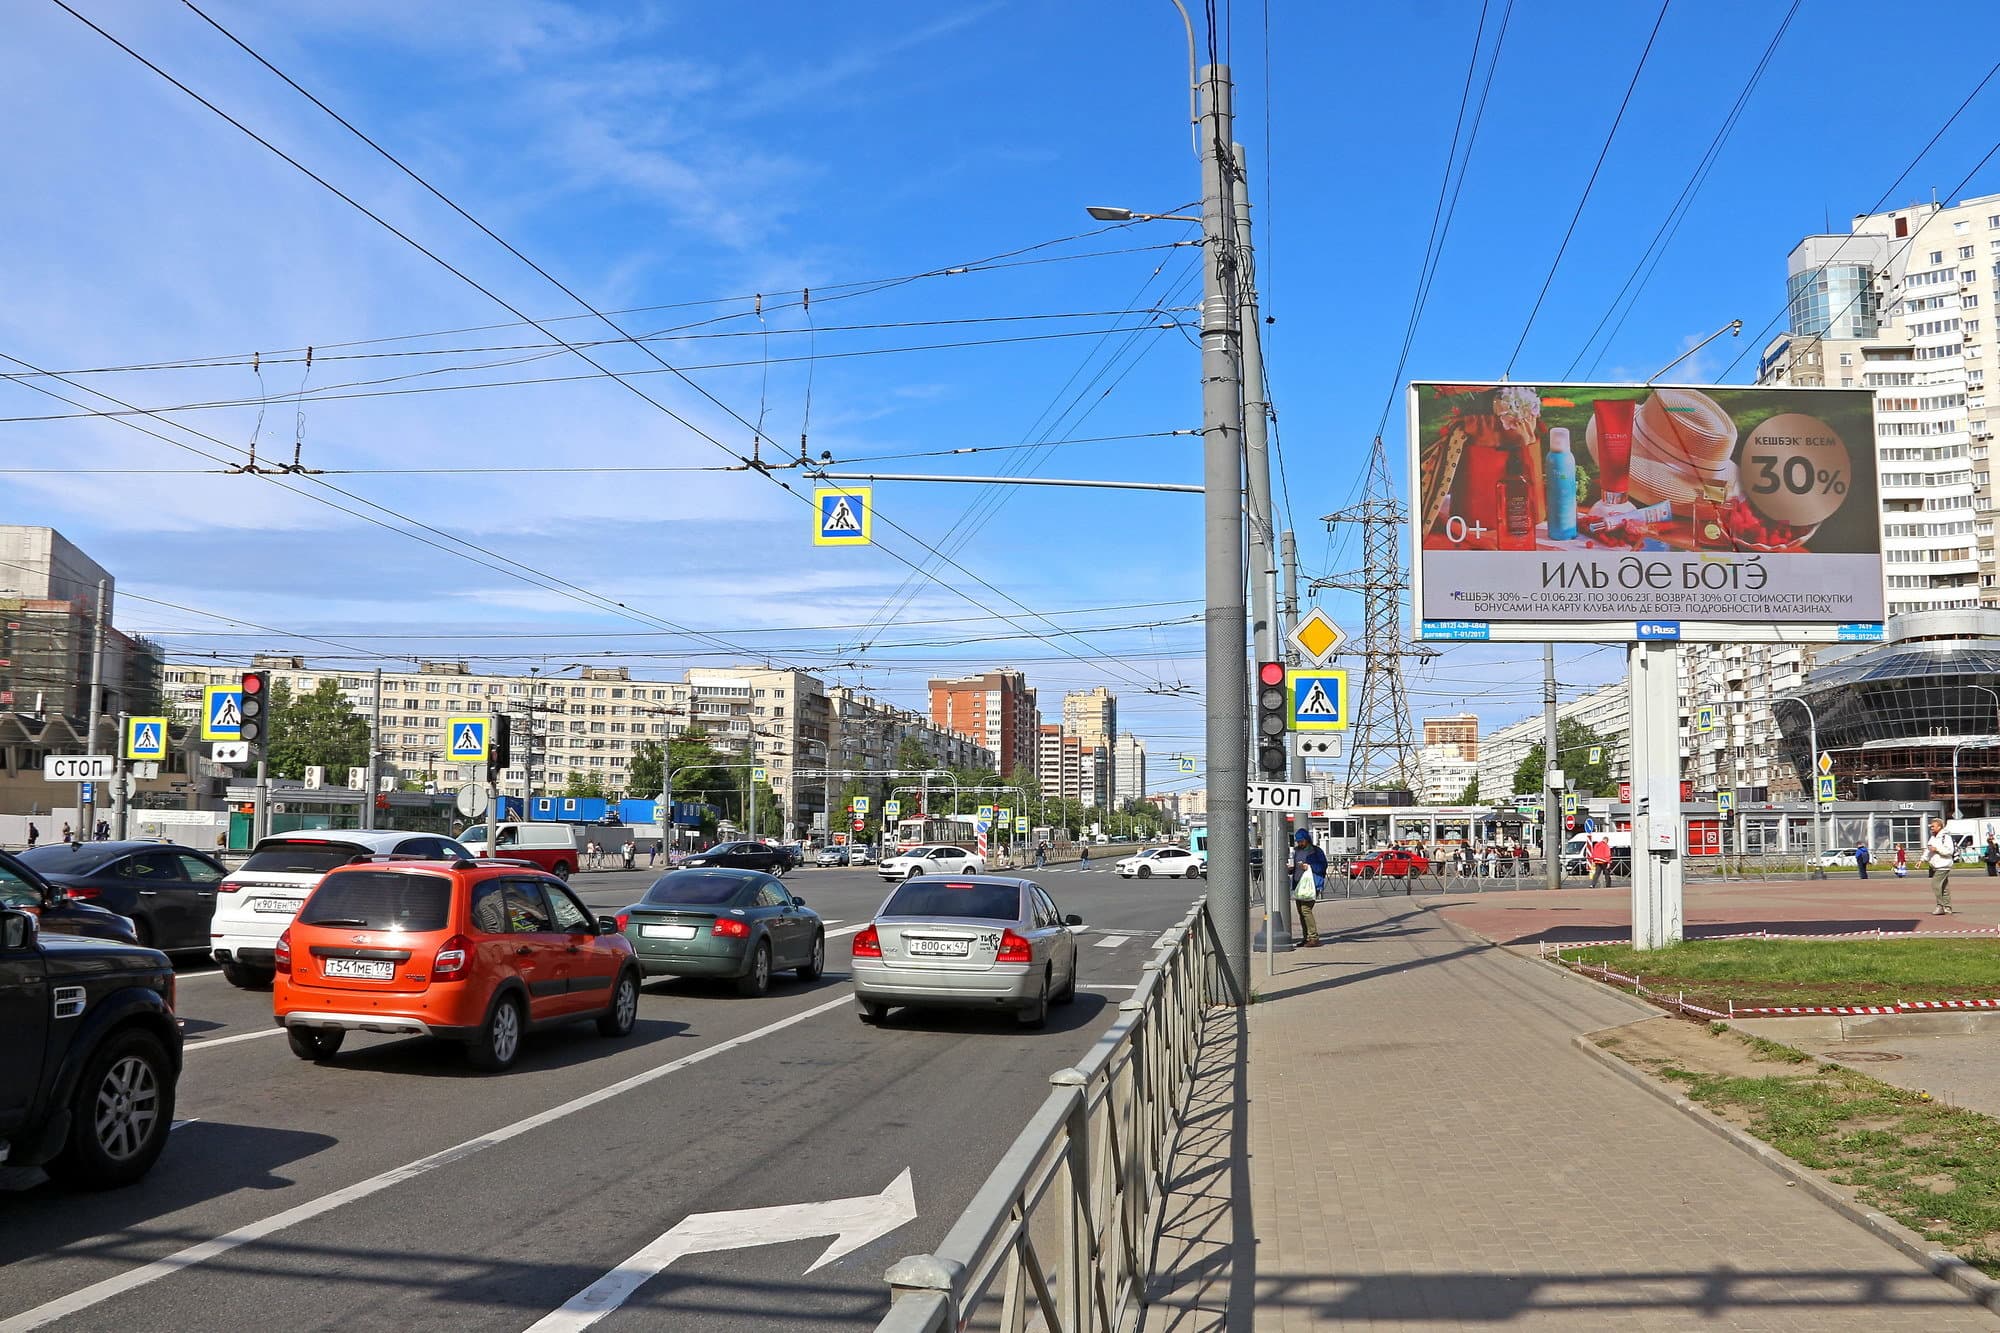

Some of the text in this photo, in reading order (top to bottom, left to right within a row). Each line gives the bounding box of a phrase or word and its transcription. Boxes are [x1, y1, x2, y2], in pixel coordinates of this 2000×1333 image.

[1805, 437, 1836, 447] ВСЕМ
[1751, 455, 1846, 495] 30%
[1446, 515, 1488, 543] 0+
[1542, 561, 1609, 589] ИЛЬ
[1498, 592, 1520, 601] 30%
[1530, 592, 1538, 601] С
[1588, 592, 1604, 602] ПО
[1656, 593, 1697, 602] ВОЗВРАТ
[1700, 593, 1721, 602] 30%
[1724, 593, 1737, 602] ОТ
[1740, 593, 1803, 603] СТОИМОСТИ
[1805, 594, 1853, 603] ПОКУПКИ
[1474, 603, 1833, 614] БОНУСАМИ НА КАРТУ КЛУБА ИЛЬ ДЕ БОТЭ. ПОДРОБНОСТИ В МАГАЗИНАХ.
[1652, 625, 1677, 635] Russ
[54, 760, 102, 777] СТОП
